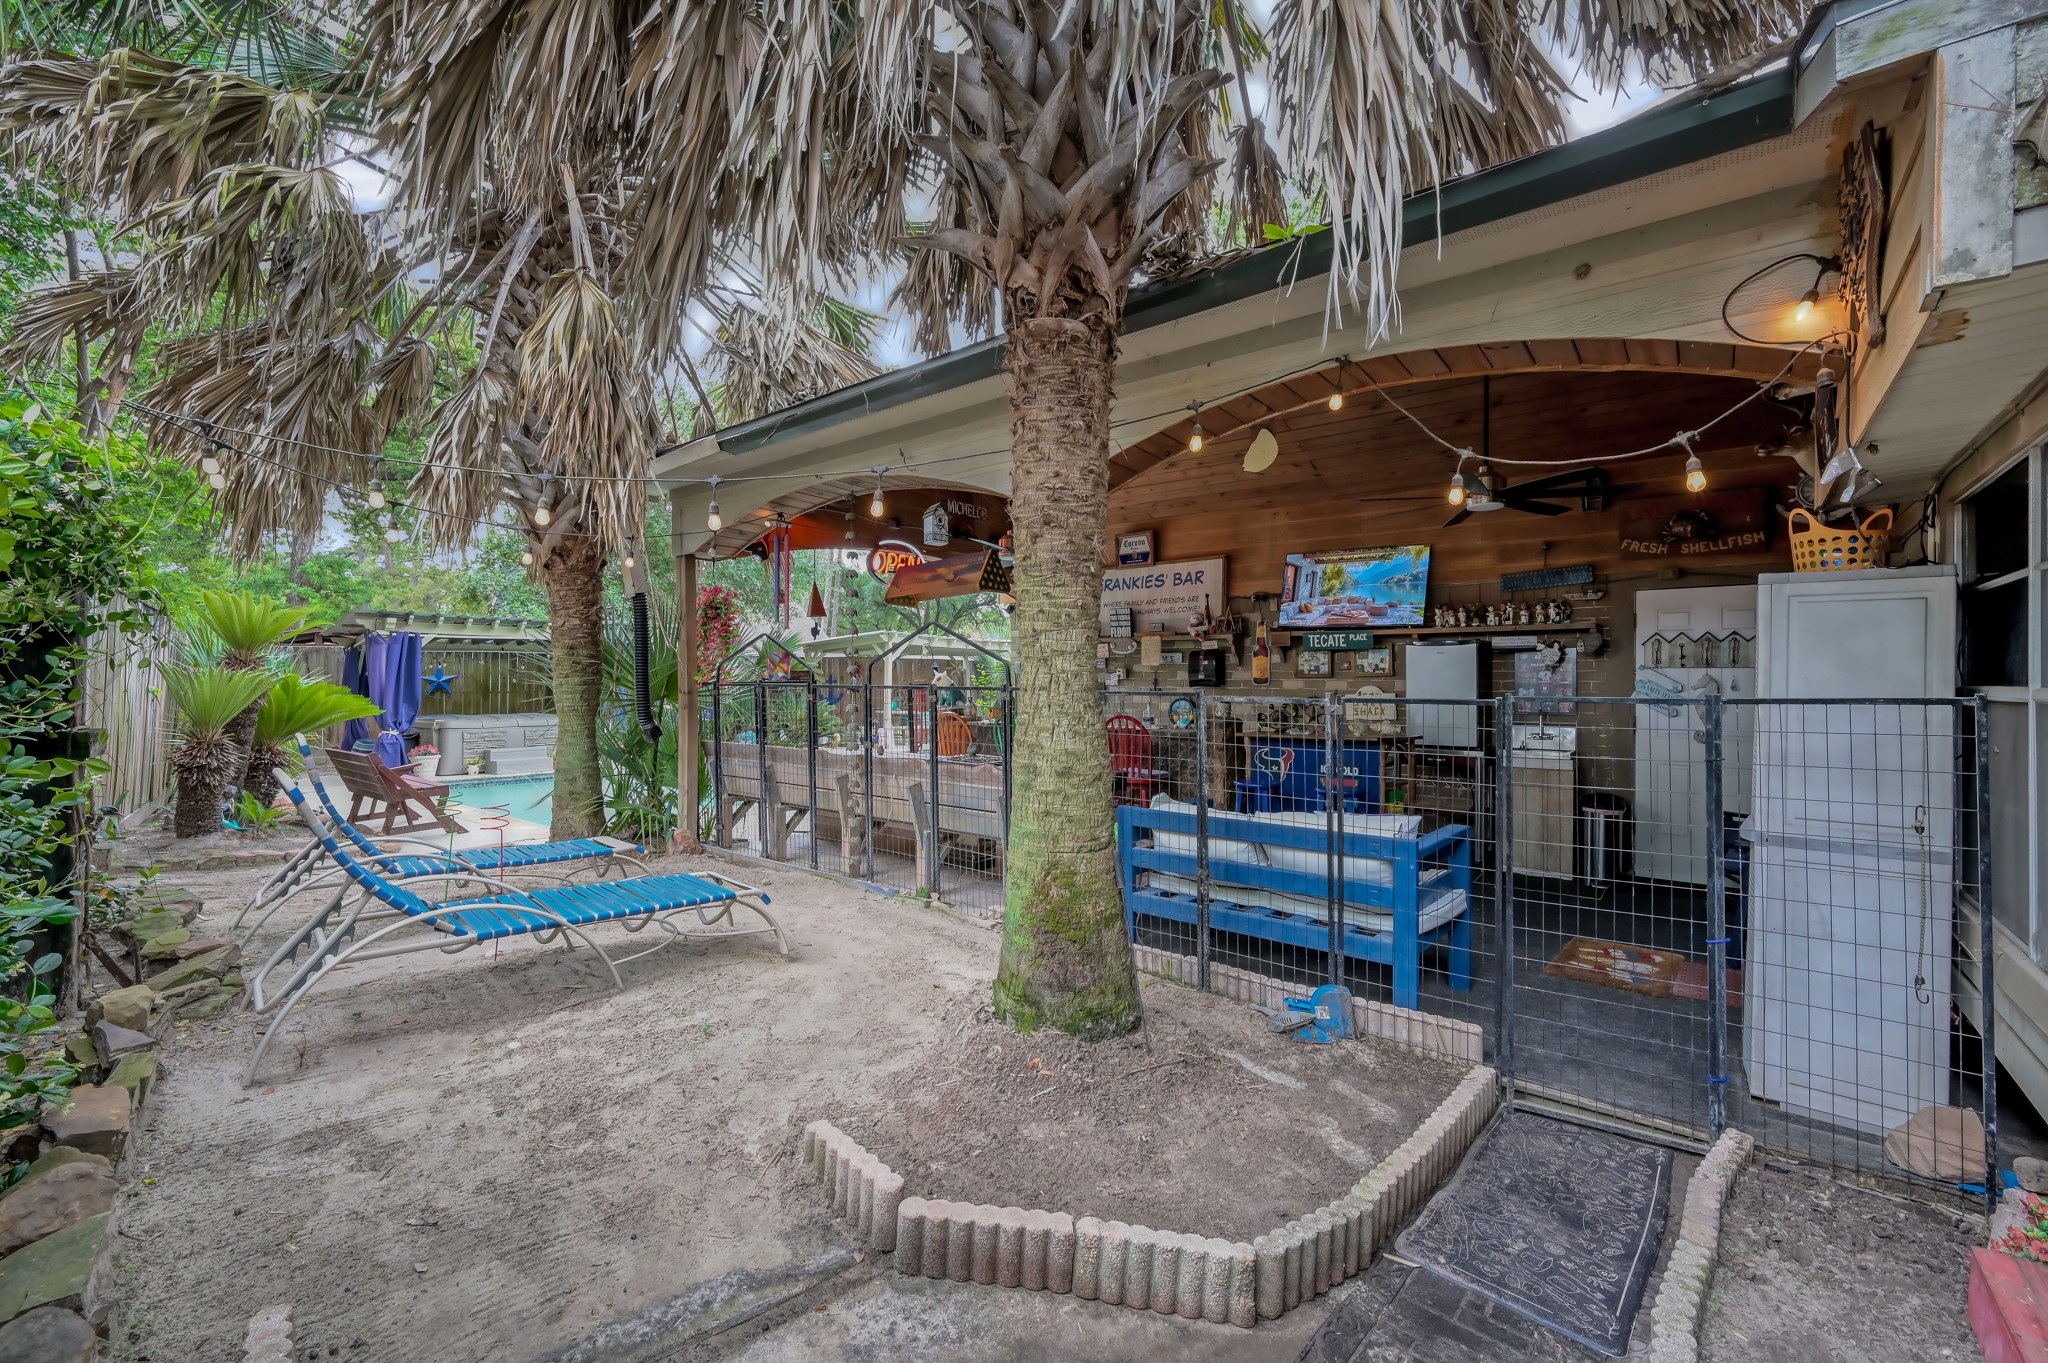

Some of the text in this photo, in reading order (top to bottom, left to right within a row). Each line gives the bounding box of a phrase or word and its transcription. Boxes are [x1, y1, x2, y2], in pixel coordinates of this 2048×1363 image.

[1123, 539, 1146, 548] Corona
[1620, 530, 1766, 554] FRESH SHELLFISH
[872, 551, 921, 573] OPEN
[1104, 570, 1205, 591] RANKIES' BAR
[1103, 600, 1123, 608] WHERE
[1124, 599, 1145, 607] FAMILY
[1187, 595, 1200, 603] ARE
[1137, 605, 1201, 615] ALWAYS WELCOME!
[1111, 626, 1132, 638] FLOOR
[1308, 633, 1368, 648] TECATE PLACE
[1354, 707, 1386, 716] SHACK
[1320, 764, 1334, 774] IC
